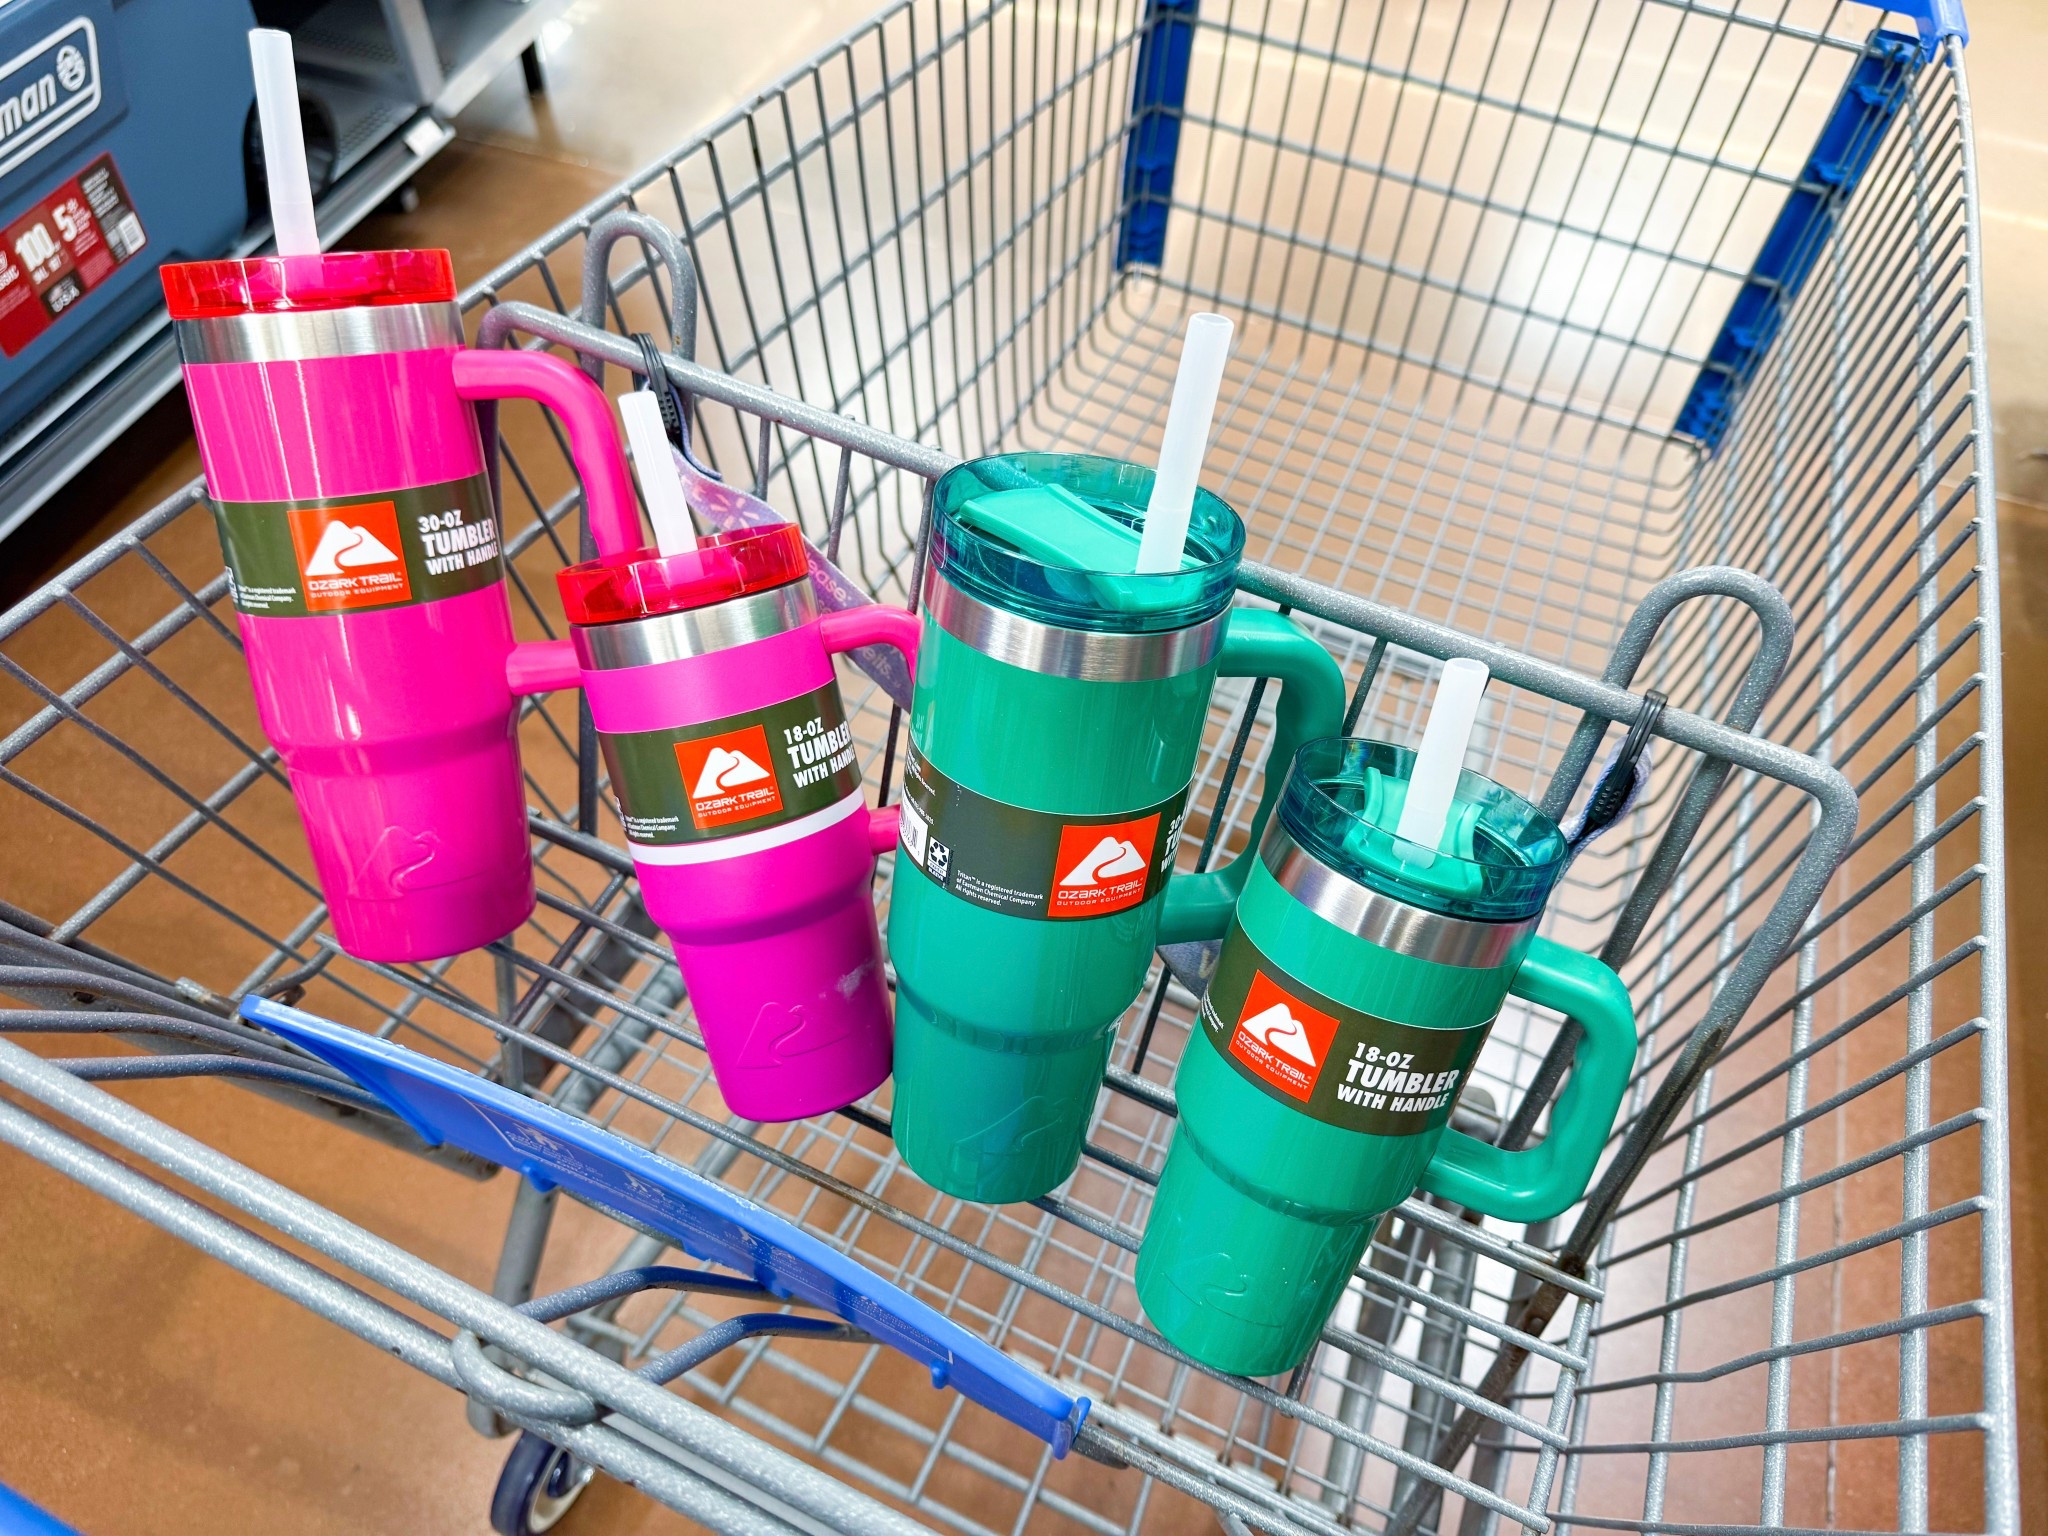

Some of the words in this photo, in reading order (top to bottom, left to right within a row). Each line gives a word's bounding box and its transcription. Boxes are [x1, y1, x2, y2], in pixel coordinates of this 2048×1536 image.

[52, 204, 78, 242] 5
[15, 223, 55, 272] 100
[51, 284, 80, 312] USA
[417, 509, 463, 533] 30-OZ
[421, 518, 496, 557] TUMBLER
[425, 553, 465, 576] WITH
[308, 578, 358, 591] OZARK
[358, 573, 403, 586] TRAIL
[311, 589, 351, 599] OUTDOOR
[354, 583, 403, 595] EQUIPMENT
[783, 716, 824, 745] 18-OZ
[792, 761, 829, 789] WITH
[695, 796, 738, 811] OZARK
[738, 788, 775, 802] TRAIL
[698, 808, 731, 818] OUTDOOR
[735, 796, 775, 811] EQUIPMENT
[962, 879, 984, 893] Eastman
[984, 888, 1009, 901] Chemical
[1009, 895, 1037, 906] Company.
[962, 887, 977, 898] rights
[977, 894, 1002, 906] reserved.
[985, 882, 1014, 895] registered
[1013, 890, 1044, 900] trademark
[1058, 888, 1107, 899] OZARK
[1109, 880, 1142, 894] TRAIL
[1100, 888, 1142, 903] EQUIPMENT
[1235, 1040, 1263, 1065] OUTDOOR
[1265, 1064, 1308, 1090] EQUIPMENT
[1238, 1031, 1274, 1063] OZARK
[1274, 1057, 1310, 1085] TRAIL
[1355, 1041, 1415, 1070] 18-OZ
[1345, 1058, 1460, 1094] TUMBLER
[1337, 1083, 1387, 1110] WITH
[1389, 1092, 1450, 1112] HANDLE
